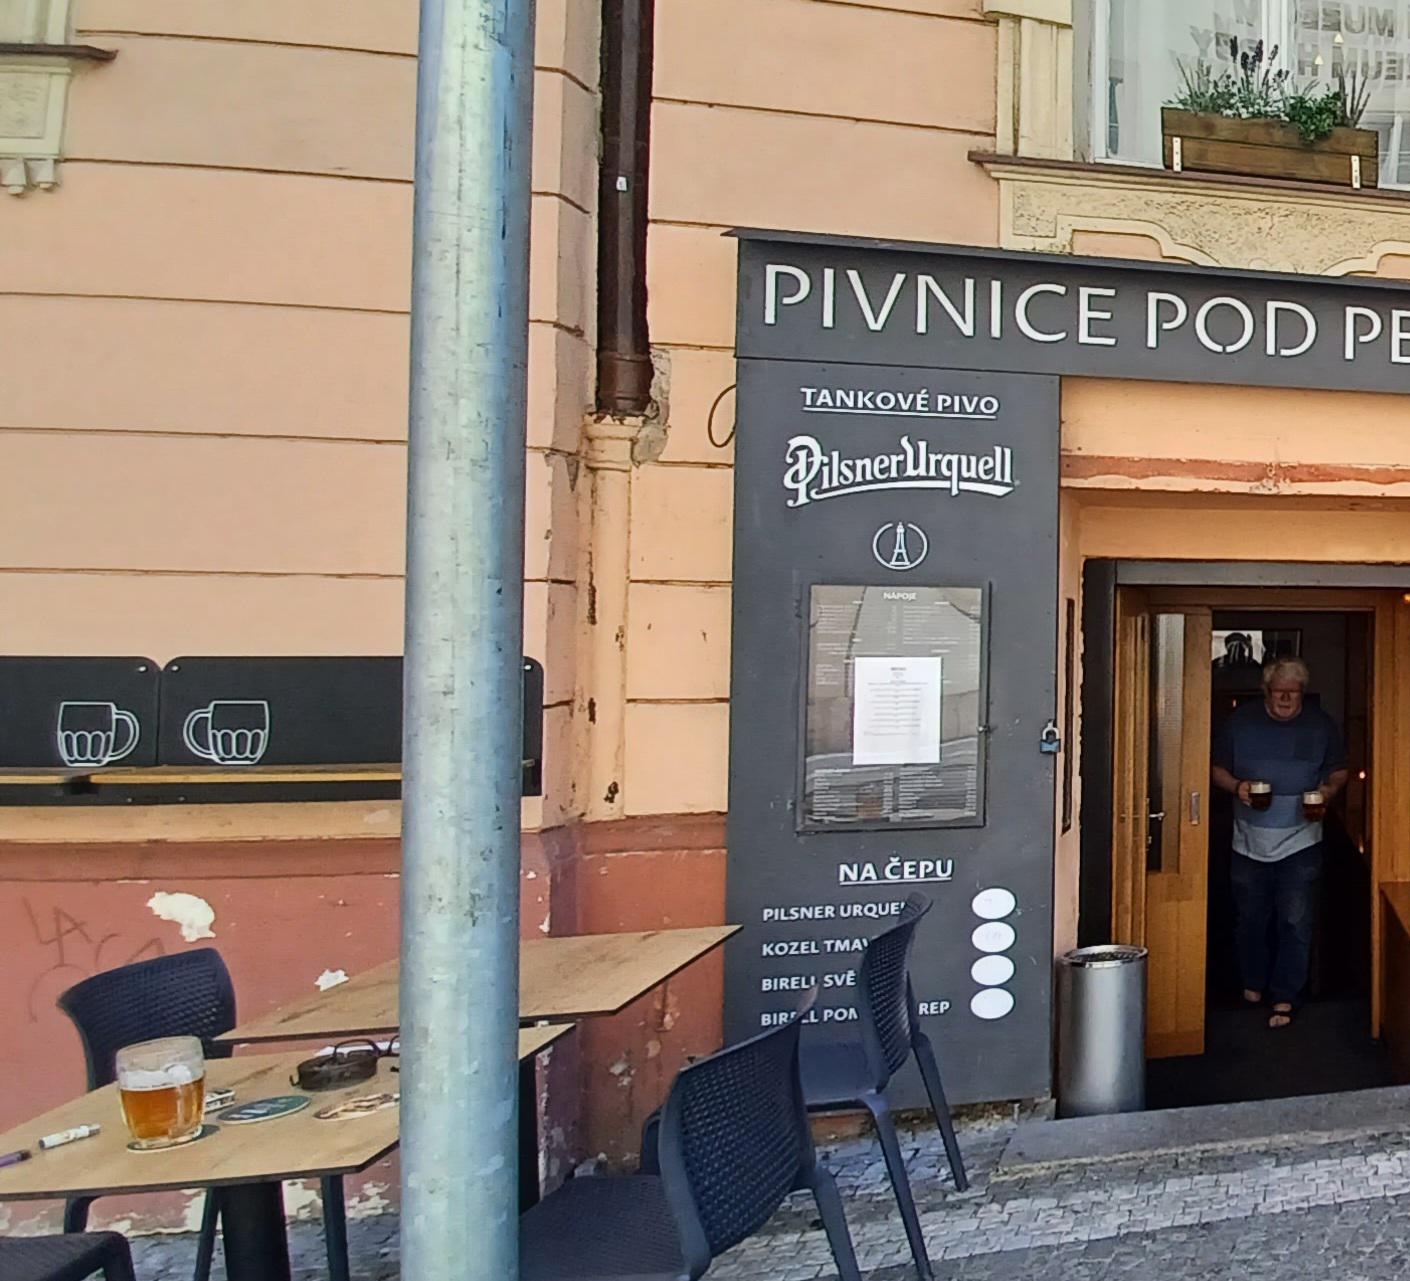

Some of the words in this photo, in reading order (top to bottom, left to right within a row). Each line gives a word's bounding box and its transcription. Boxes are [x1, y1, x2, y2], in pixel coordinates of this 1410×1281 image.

[763, 263, 1117, 346] PIVNICE
[1146, 291, 1318, 355] POD
[800, 387, 929, 412] TANKOVÉ
[936, 396, 1000, 414] PIVO
[783, 435, 904, 507] Pilsner
[901, 435, 1013, 497] Urquell
[839, 863, 878, 882] NA
[884, 856, 953, 880] ČEPU
[762, 904, 836, 921] PILSNER
[839, 901, 906, 918] URQUE
[762, 940, 820, 957] KOZEL
[823, 938, 869, 953] TMA
[918, 1000, 950, 1016] REP
